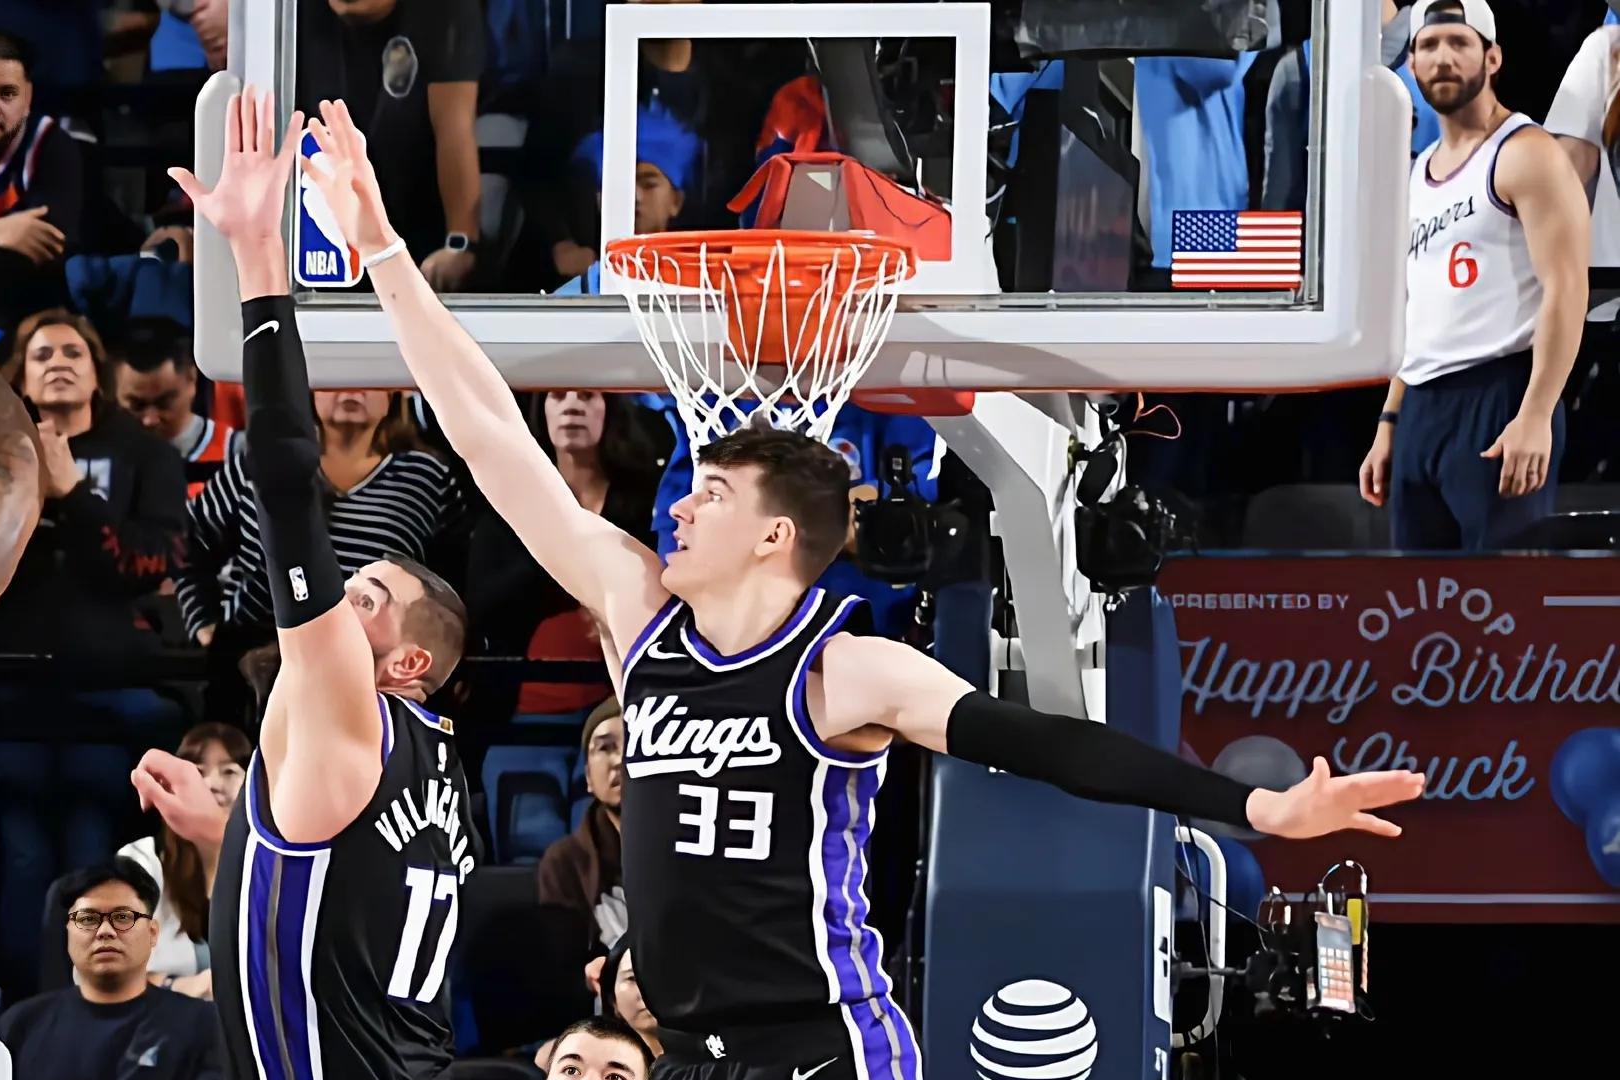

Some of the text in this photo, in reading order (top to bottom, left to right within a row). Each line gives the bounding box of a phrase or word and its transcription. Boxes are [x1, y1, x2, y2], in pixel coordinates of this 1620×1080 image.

[1407, 195, 1476, 261] ippers
[305, 250, 338, 276] NBA
[1448, 241, 1479, 289] 6
[1318, 593, 1349, 611] BY
[1357, 576, 1516, 641] OLIPOP
[1177, 635, 1378, 725] Happy
[623, 694, 782, 779] Kings
[674, 783, 775, 861] 33
[386, 865, 460, 1005] 17
